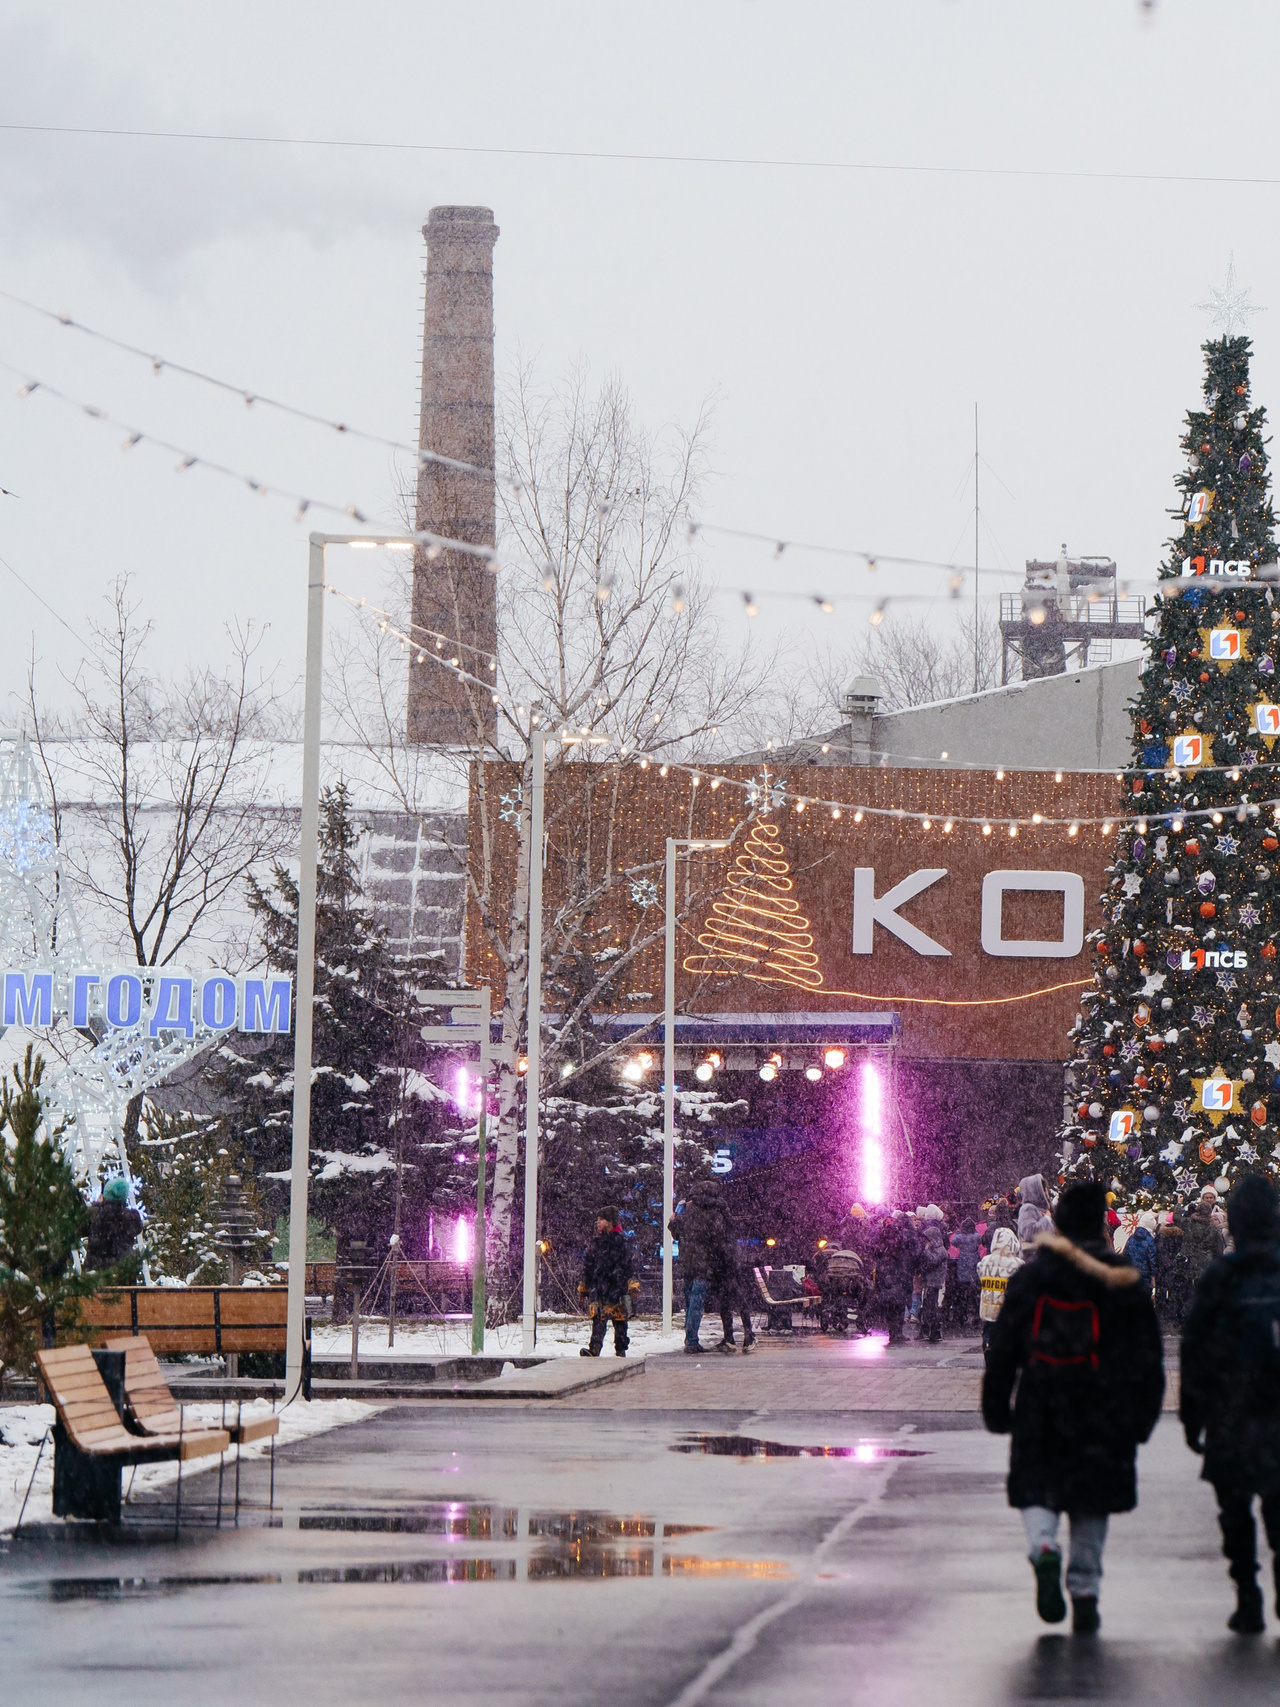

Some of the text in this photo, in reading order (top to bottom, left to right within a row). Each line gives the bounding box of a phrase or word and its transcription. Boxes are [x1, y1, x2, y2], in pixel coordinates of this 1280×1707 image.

[1209, 559, 1251, 577] ПСБ
[1205, 950, 1248, 969] ПСБ
[72, 973, 292, 1039] ГОДОМ
